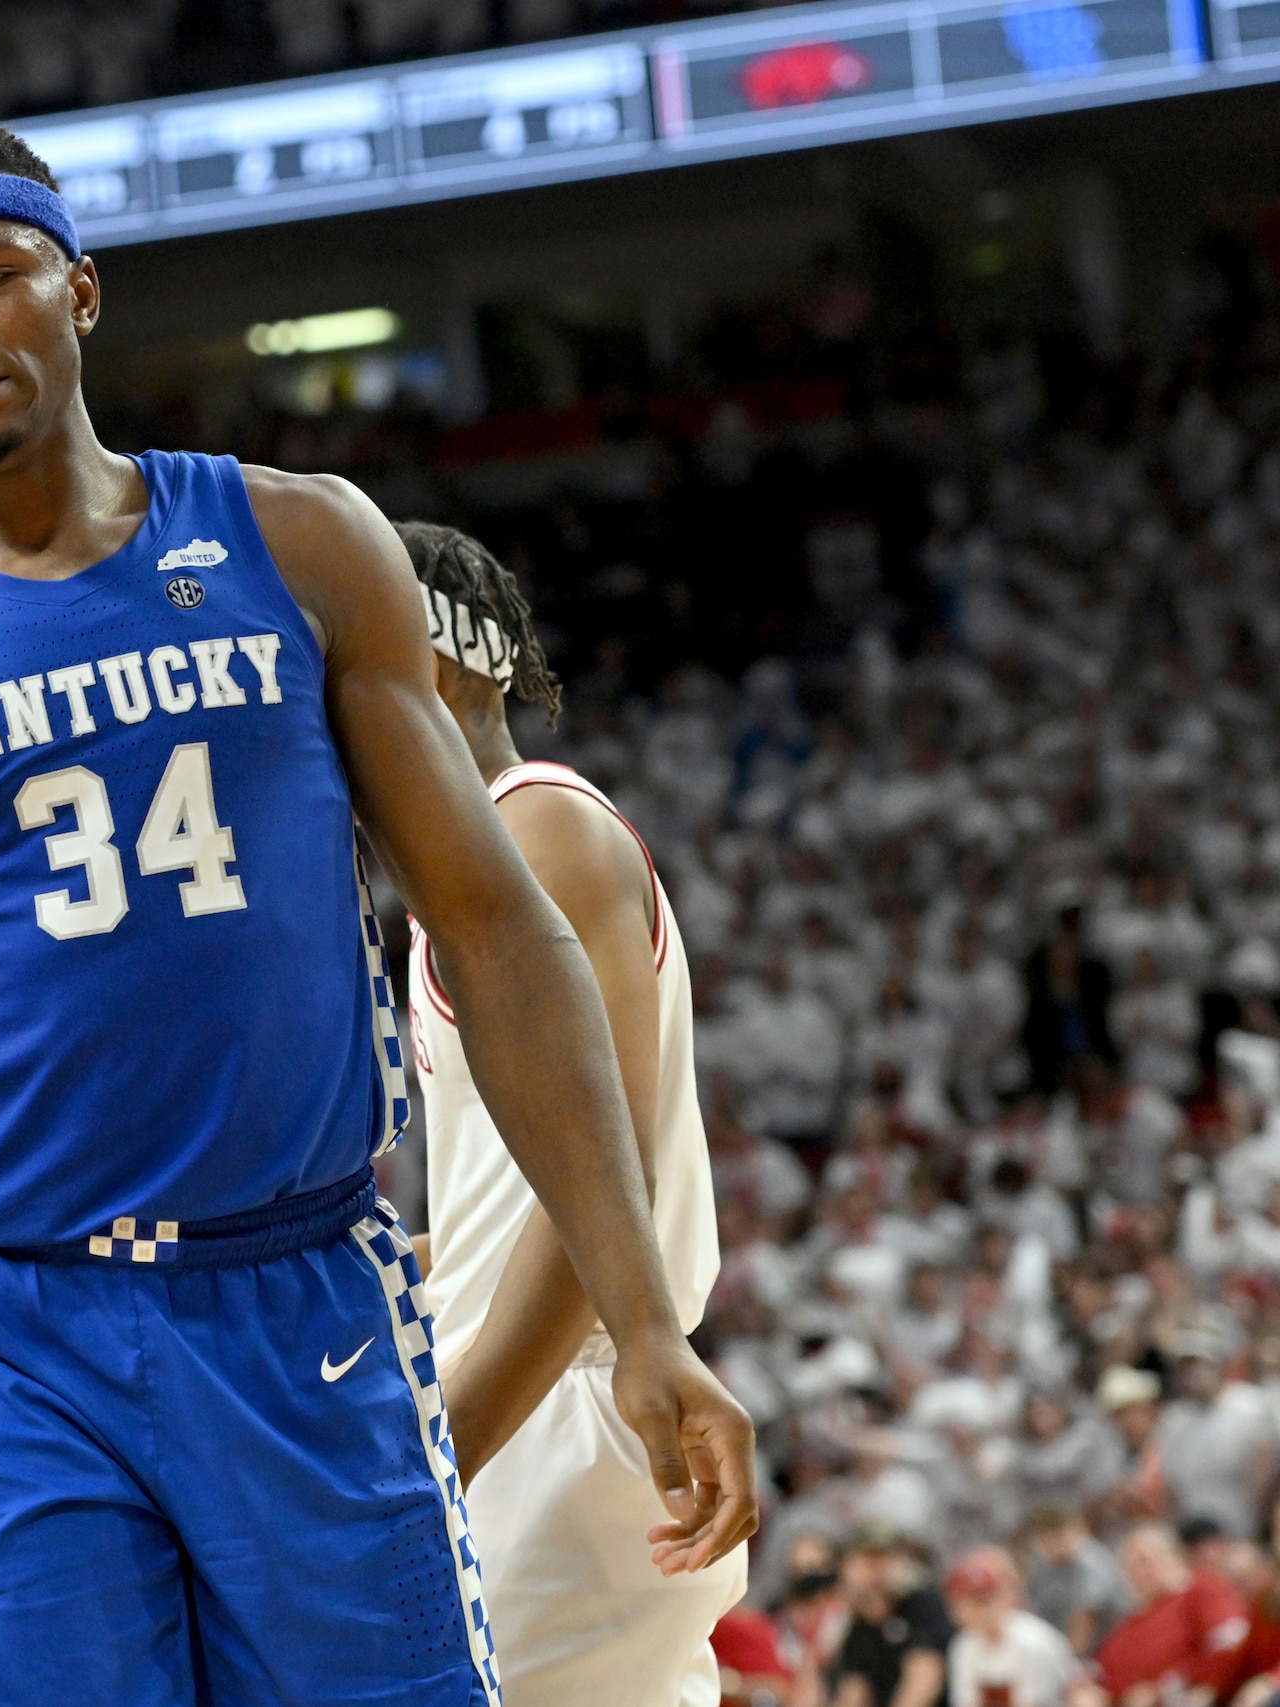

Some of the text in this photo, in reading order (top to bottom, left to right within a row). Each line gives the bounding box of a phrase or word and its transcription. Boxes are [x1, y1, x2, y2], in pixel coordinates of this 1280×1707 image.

[179, 553, 216, 564] UNITED
[167, 578, 204, 607] SEC
[13, 741, 248, 941] 34
